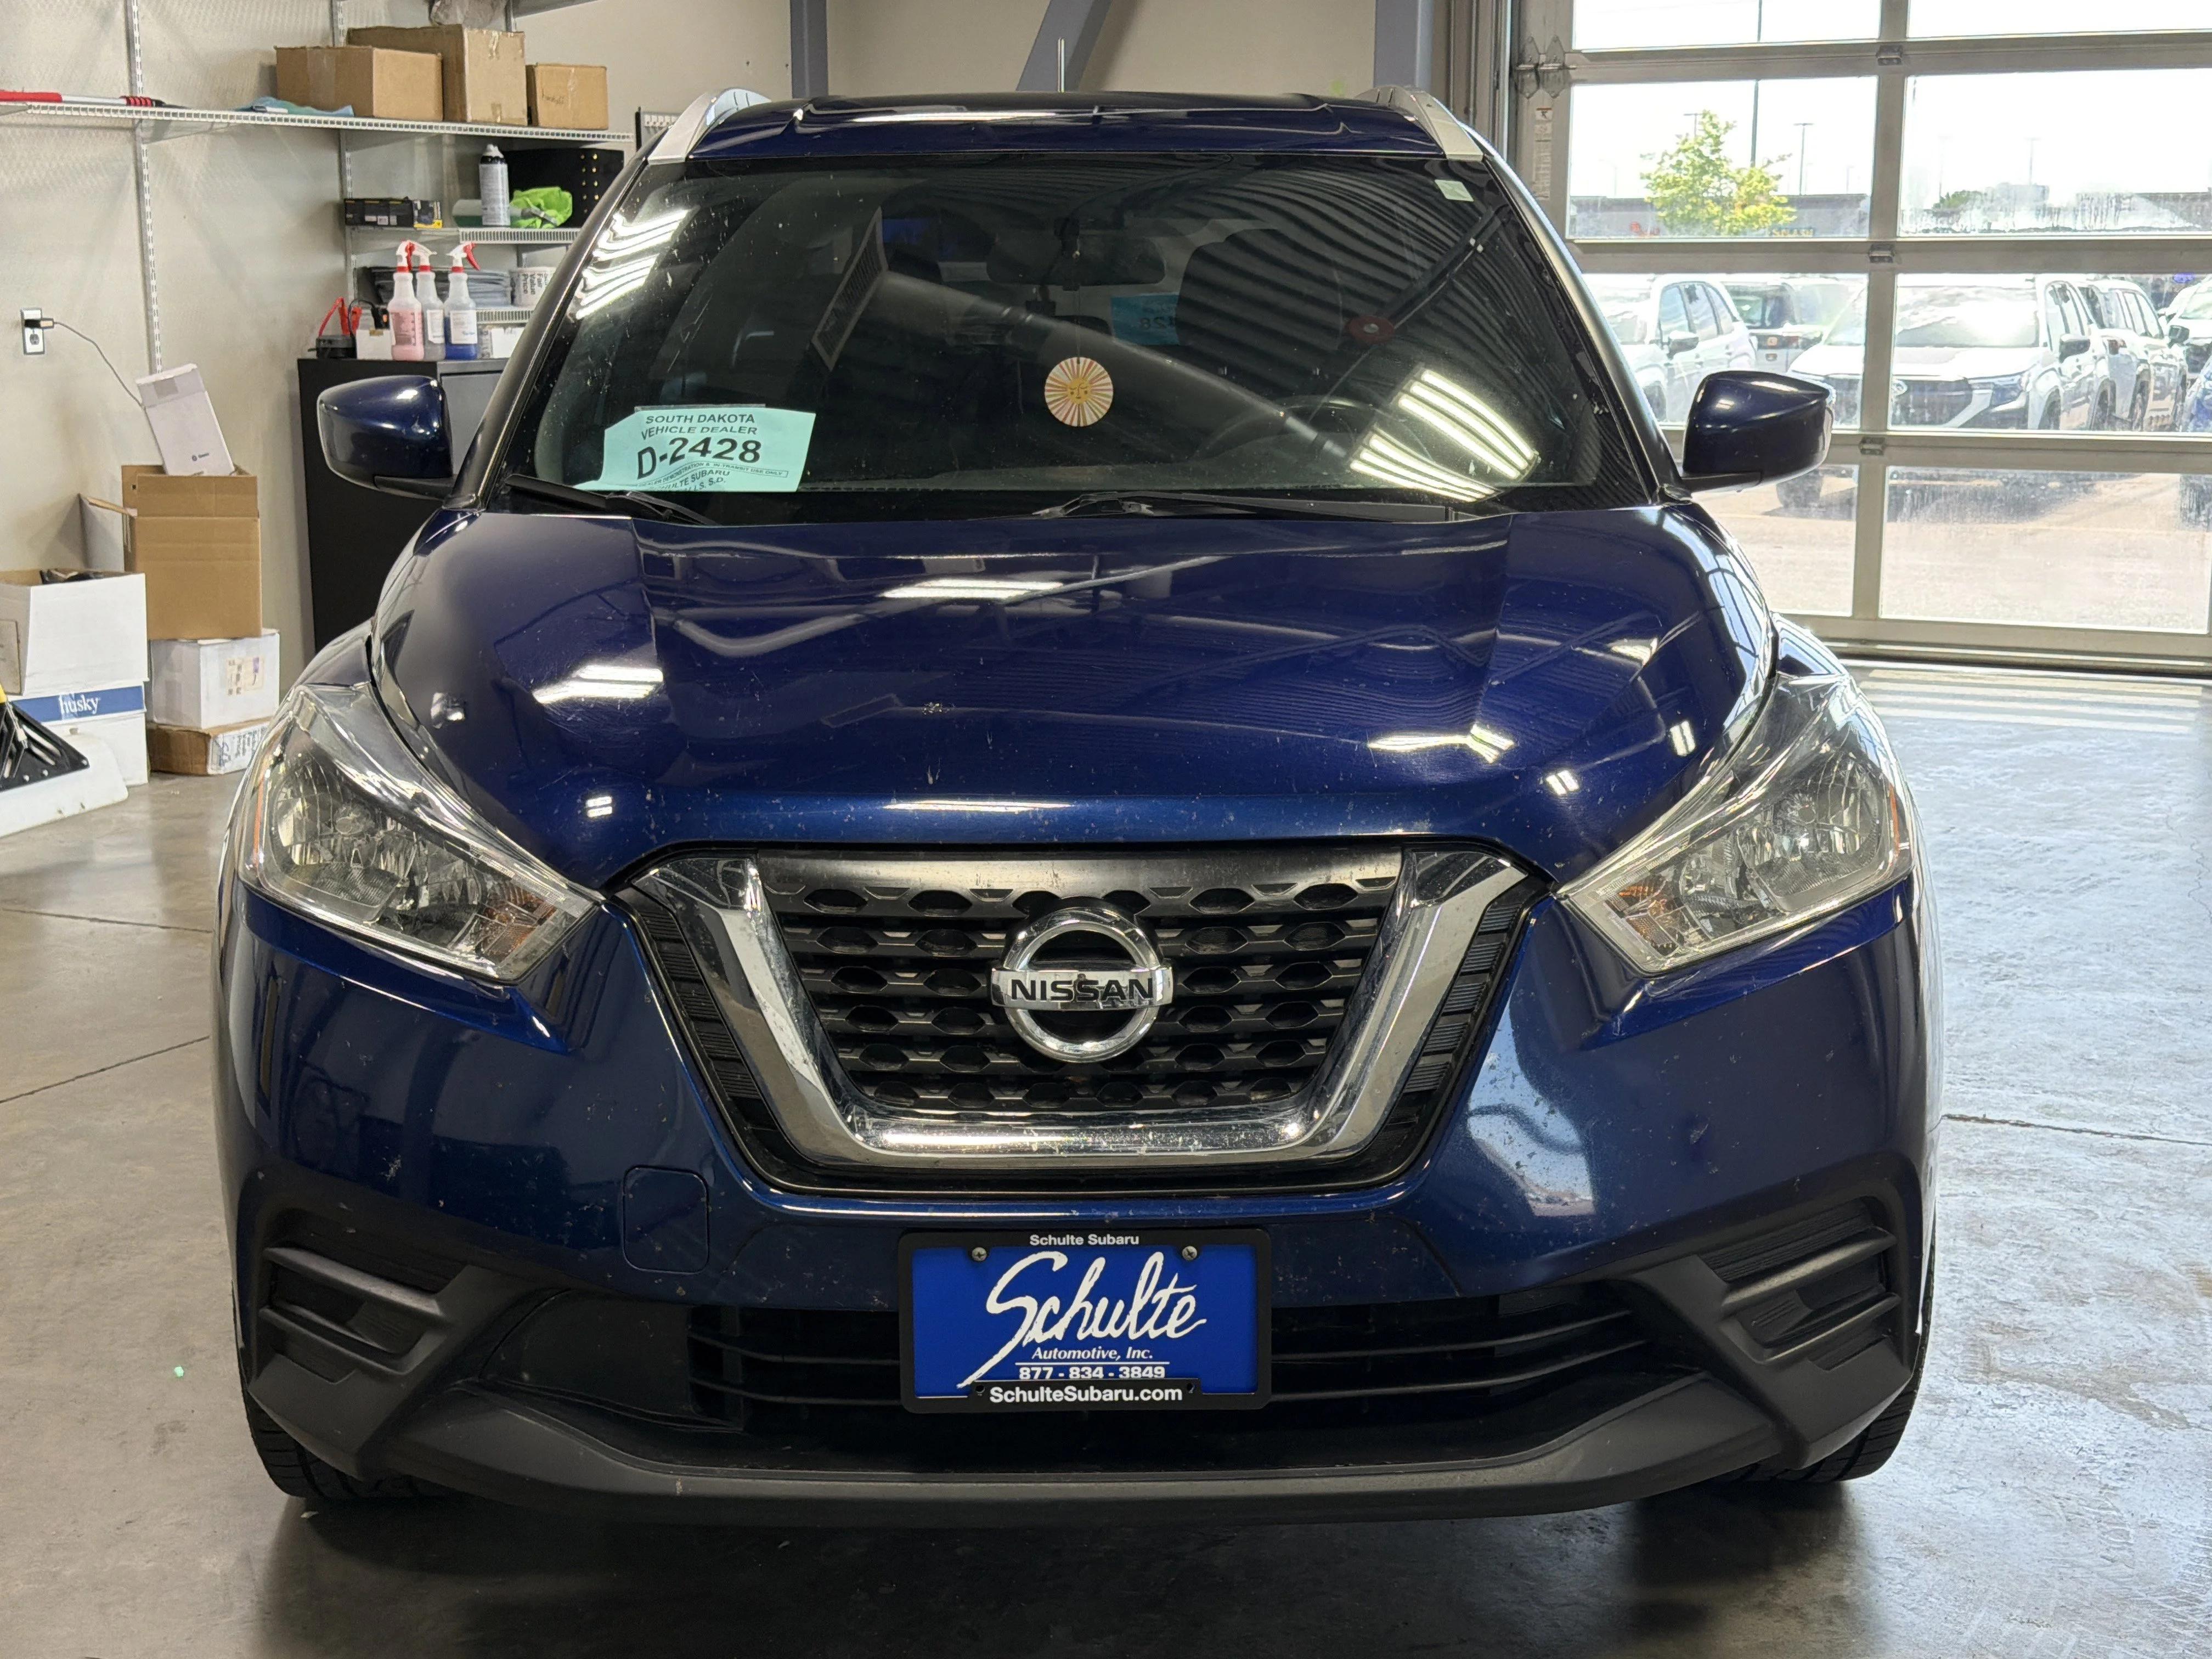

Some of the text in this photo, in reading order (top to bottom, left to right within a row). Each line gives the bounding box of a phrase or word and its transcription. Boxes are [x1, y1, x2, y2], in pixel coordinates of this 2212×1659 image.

[646, 414, 755, 424] SOUTH DAKOTA
[641, 426, 758, 440] VEHICLE DEALER
[637, 437, 761, 479] D-2428
[691, 470, 730, 483] SUBARU
[708, 477, 726, 486] S.D.
[59, 694, 99, 715] husky
[1011, 979, 1153, 1001] NISSAN
[1030, 1234, 1139, 1245] Schulte Subaru
[956, 1251, 1206, 1389] Schulte
[1031, 1346, 1153, 1361] Automotive, Inc.
[990, 1386, 1182, 1403] SchulteSubaru.com
